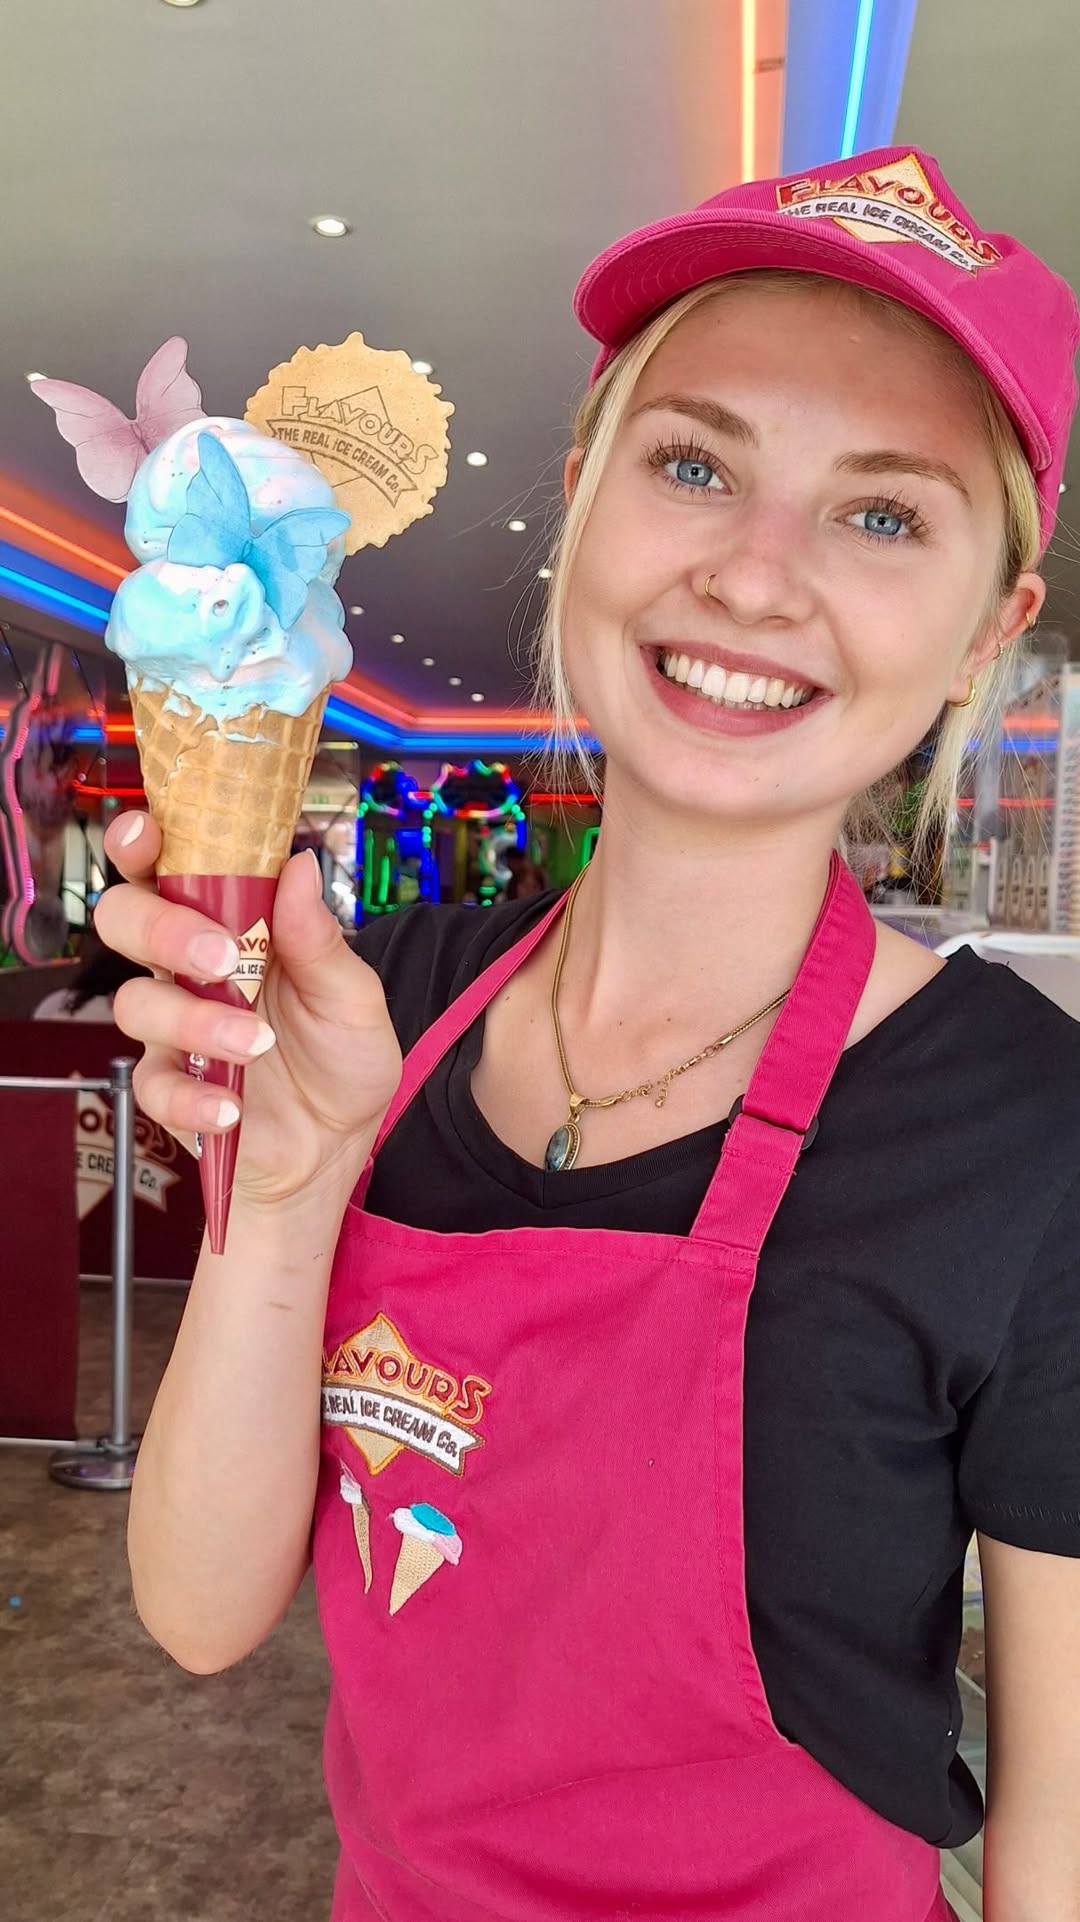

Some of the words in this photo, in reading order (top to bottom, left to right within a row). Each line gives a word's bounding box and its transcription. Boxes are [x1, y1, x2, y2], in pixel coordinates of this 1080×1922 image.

[776, 172, 1004, 265] FLAVOURS
[782, 204, 811, 216] HE
[815, 201, 857, 214] REAL
[862, 202, 891, 222] ICE
[893, 213, 951, 253] CREAM
[277, 427, 300, 442] THE
[302, 429, 330, 449] REAL
[352, 448, 390, 481] CREAM
[281, 385, 440, 475] FLAVOURS
[235, 963, 246, 975] AL
[248, 963, 258, 975] ICE
[88, 1152, 118, 1175] CRE
[322, 1344, 493, 1425] AVOURS
[328, 1394, 358, 1415] REAL
[360, 1396, 381, 1420] ICE
[383, 1405, 437, 1443] CREAM
